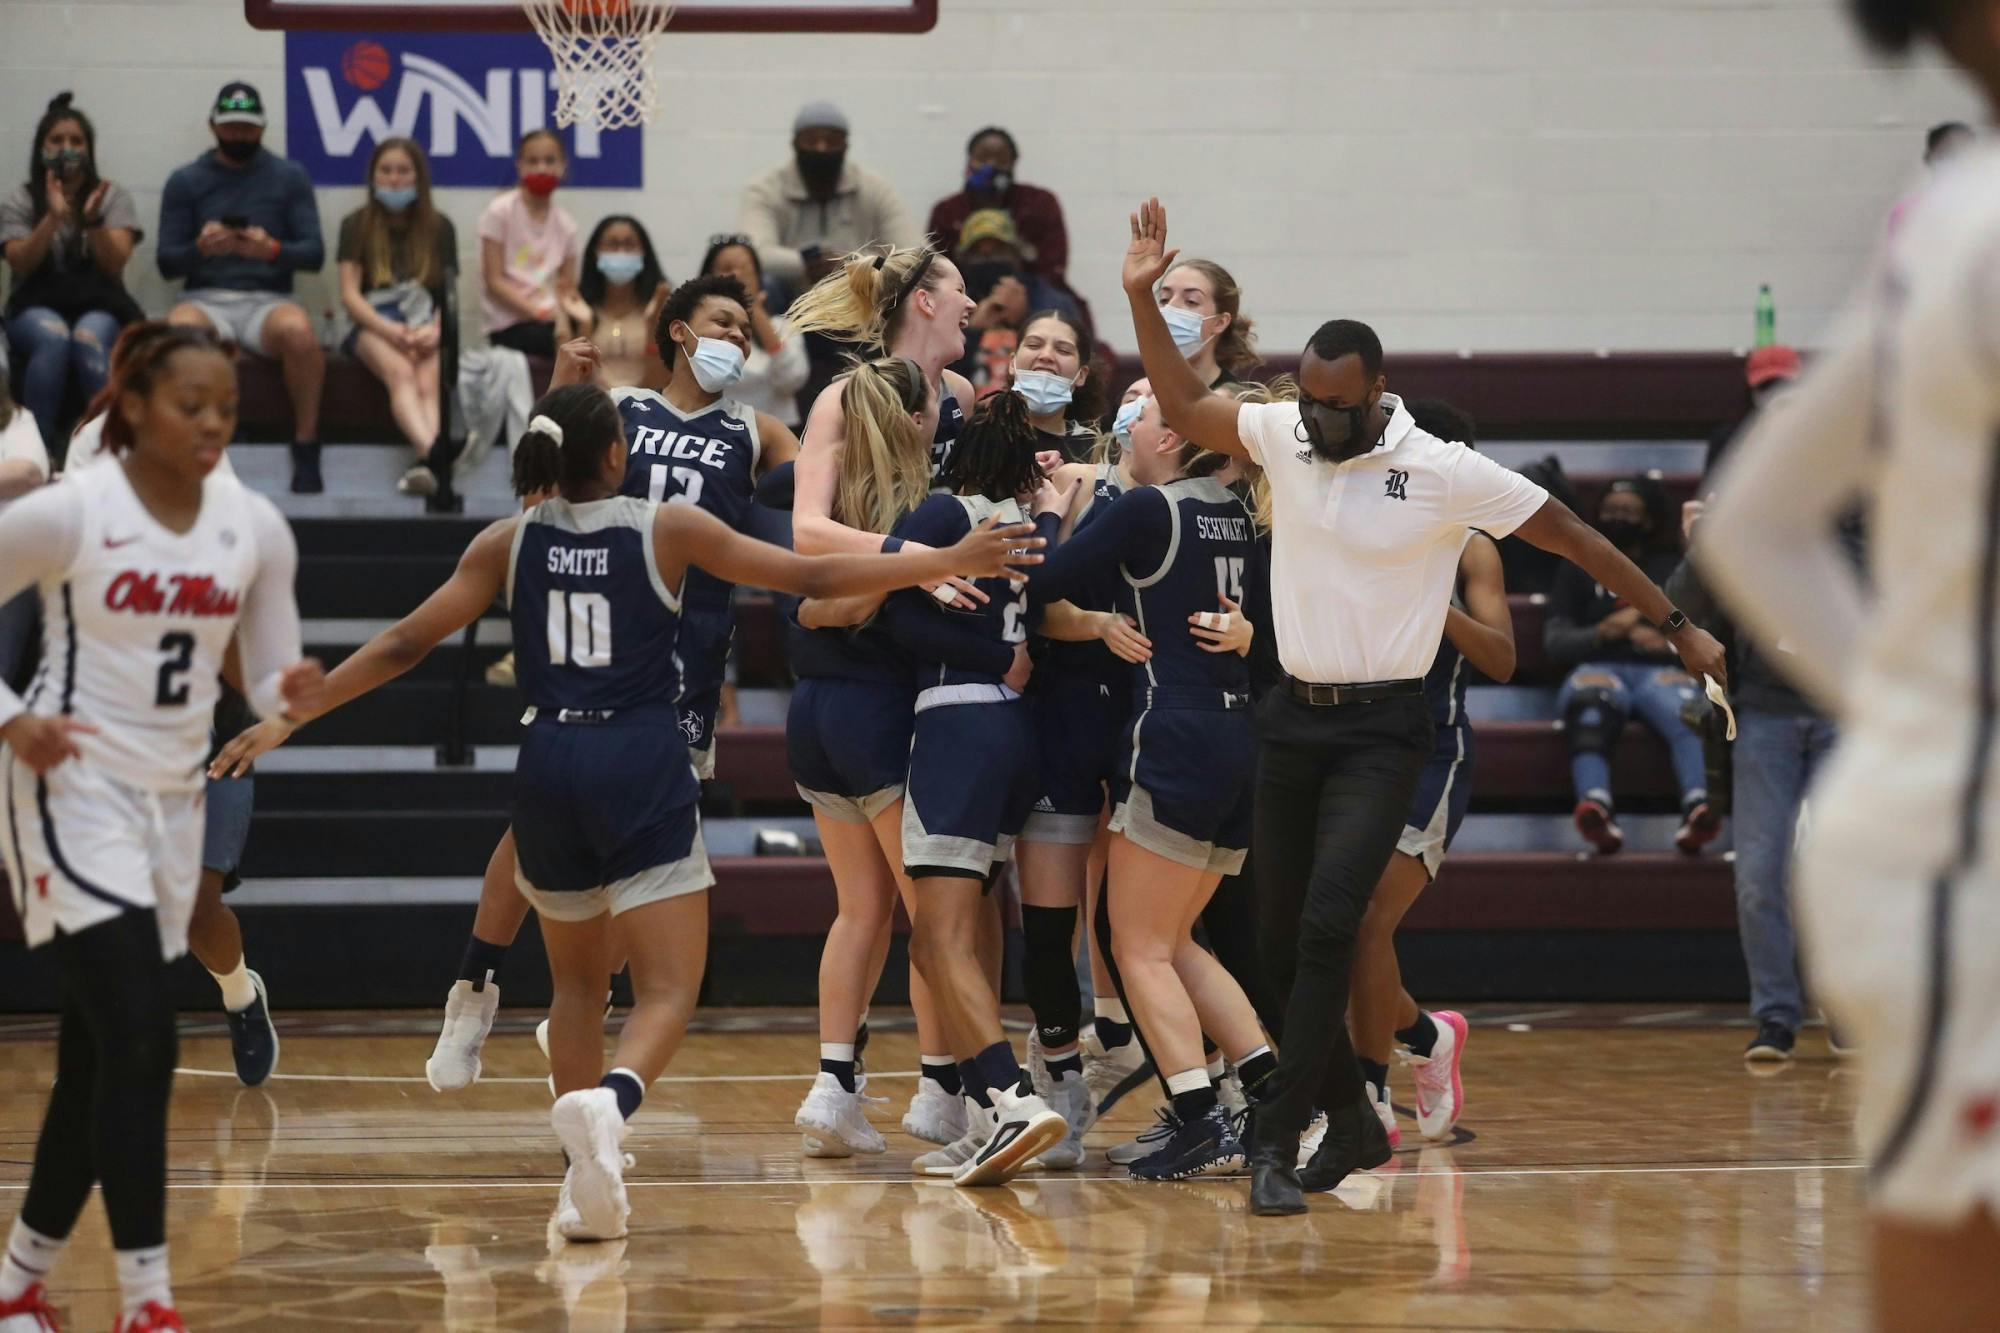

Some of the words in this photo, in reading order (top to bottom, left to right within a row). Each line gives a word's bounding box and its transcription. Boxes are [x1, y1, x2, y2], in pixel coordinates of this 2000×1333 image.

[303, 53, 625, 158] WNIT
[630, 425, 733, 470] RICE
[547, 546, 609, 576] SMITH
[1214, 556, 1245, 614] 15
[105, 570, 165, 614] Ole
[168, 574, 238, 618] Miss
[547, 588, 612, 668] 10
[155, 630, 196, 706] 2
